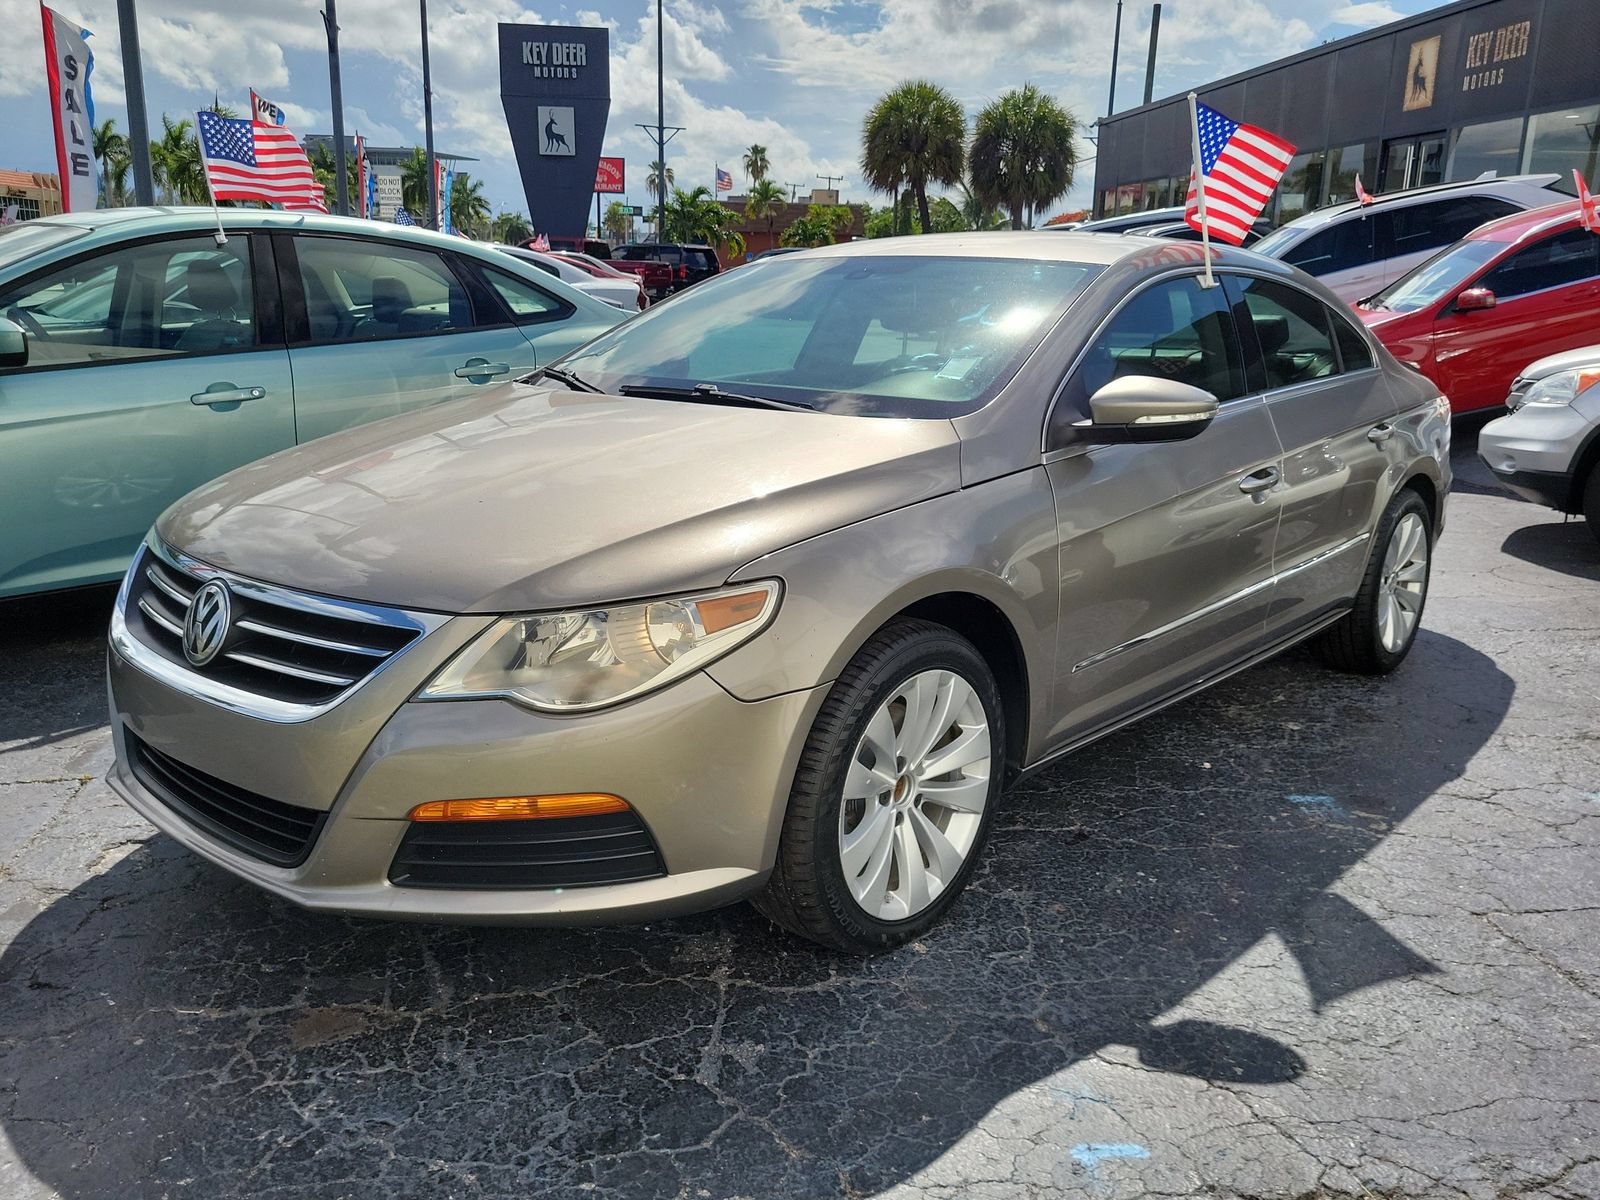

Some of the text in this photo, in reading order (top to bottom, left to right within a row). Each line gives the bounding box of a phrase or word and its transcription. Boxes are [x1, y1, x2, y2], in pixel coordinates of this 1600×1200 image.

[522, 41, 587, 66] KEY DEER
[1466, 21, 1531, 69] KEY DEER
[534, 66, 577, 79] MOTORS
[1462, 68, 1504, 92] MOTORS
[63, 54, 90, 177] SALE
[257, 98, 277, 118] WE
[388, 178, 400, 186] NOT
